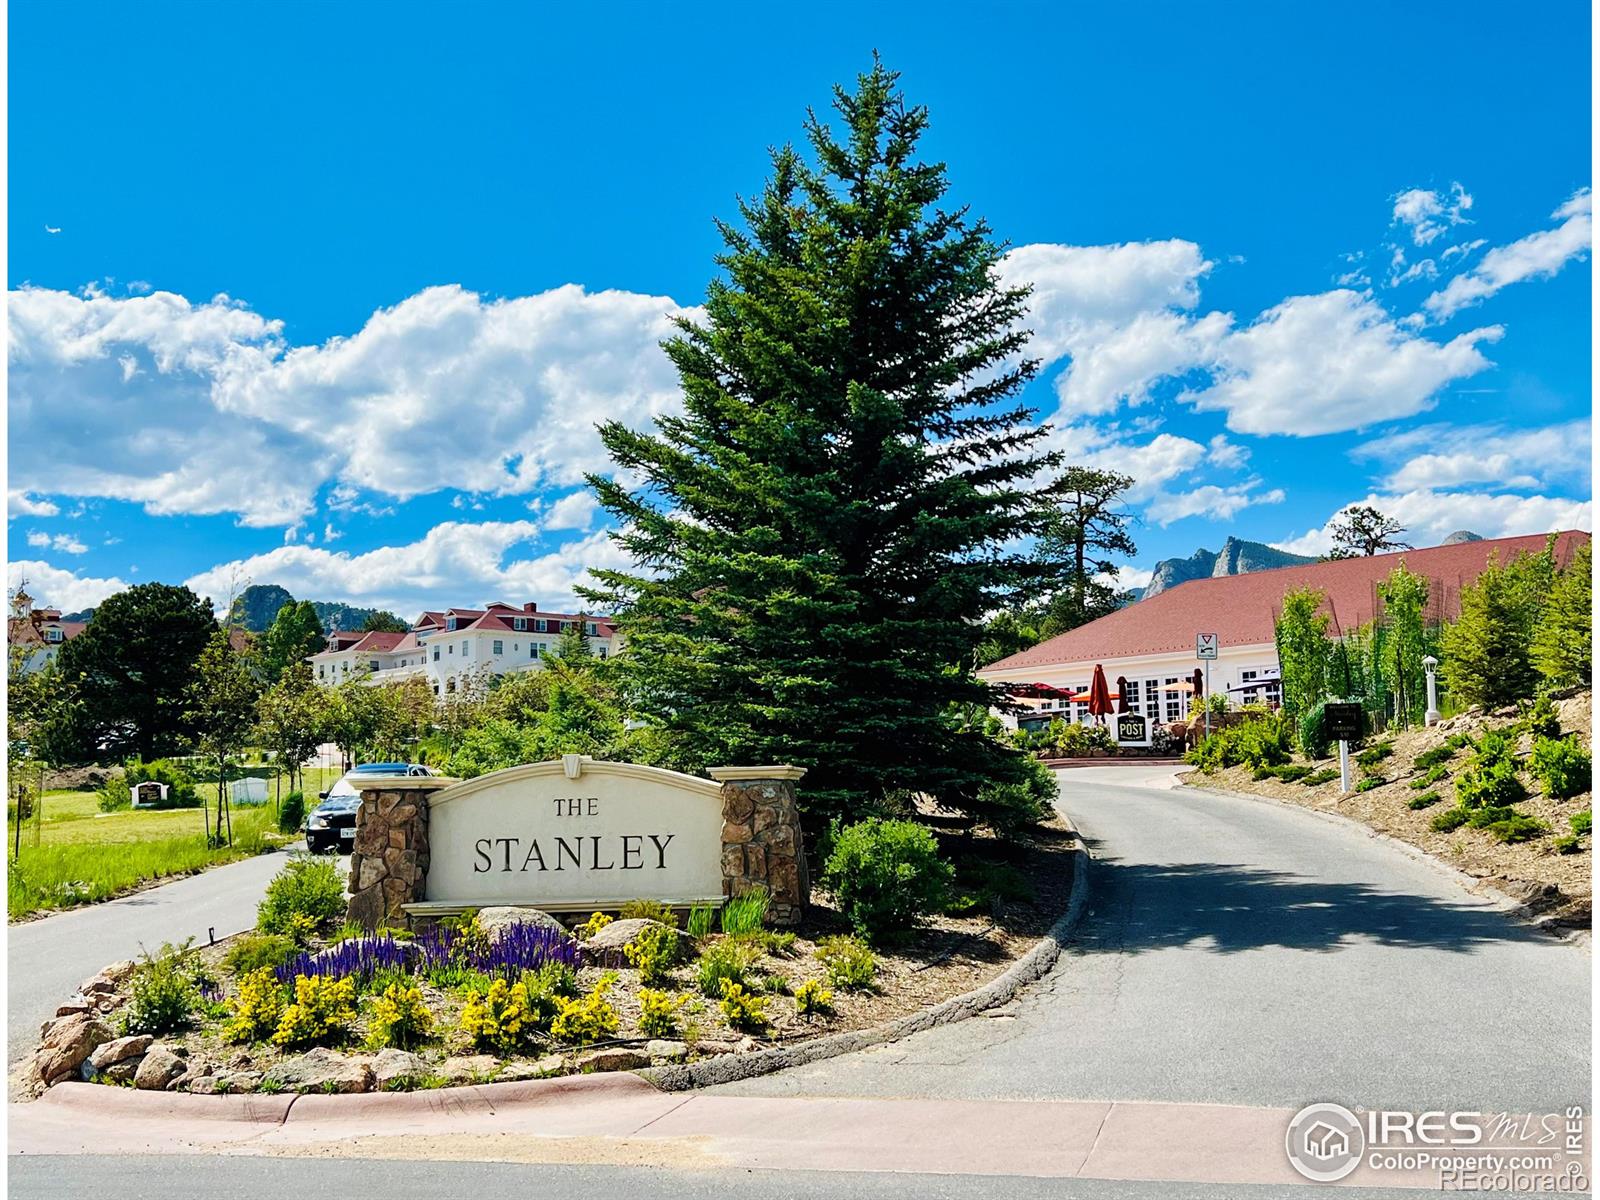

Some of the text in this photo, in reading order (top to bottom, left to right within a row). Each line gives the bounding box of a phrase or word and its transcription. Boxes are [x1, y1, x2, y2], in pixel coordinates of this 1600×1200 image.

[1119, 723, 1144, 735] POST
[553, 798, 599, 817] THE
[473, 834, 676, 873] STANLEY
